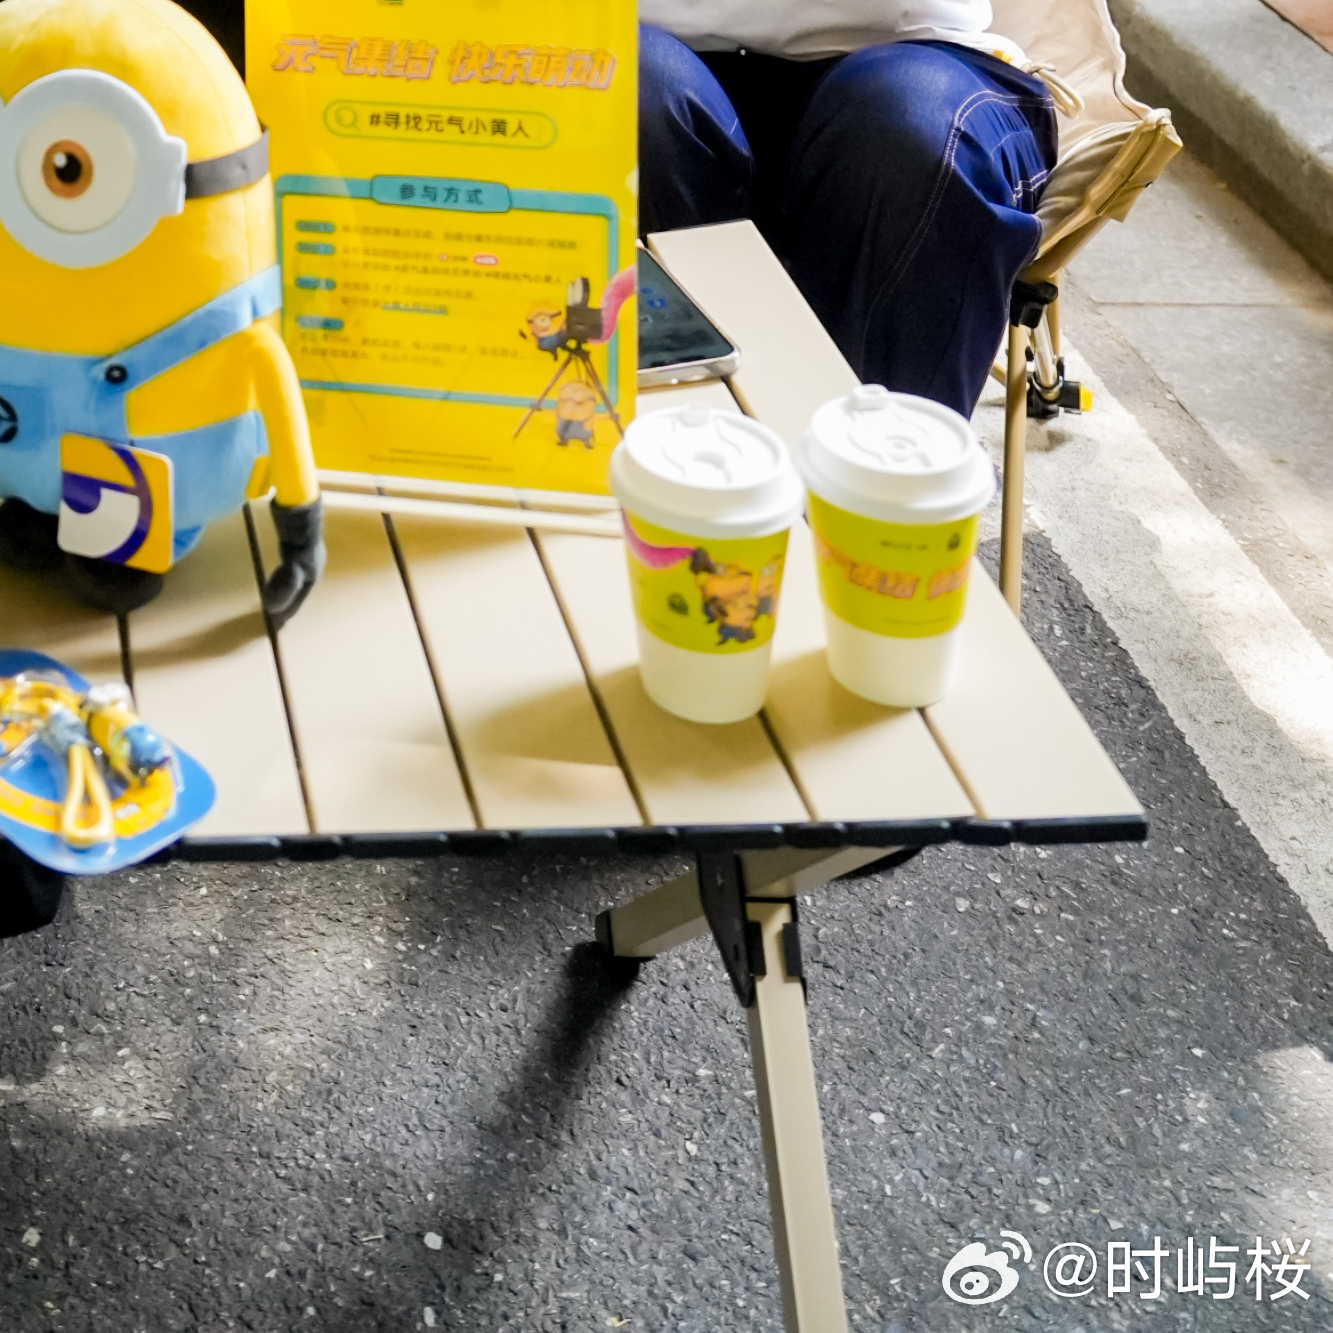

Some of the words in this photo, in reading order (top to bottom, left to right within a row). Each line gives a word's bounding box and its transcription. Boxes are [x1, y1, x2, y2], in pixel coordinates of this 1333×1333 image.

[272, 33, 438, 81] 元气集结
[448, 40, 616, 92] 快乐萌动
[368, 112, 530, 139] #寻找元气小黄人
[399, 183, 484, 206] 参与方式
